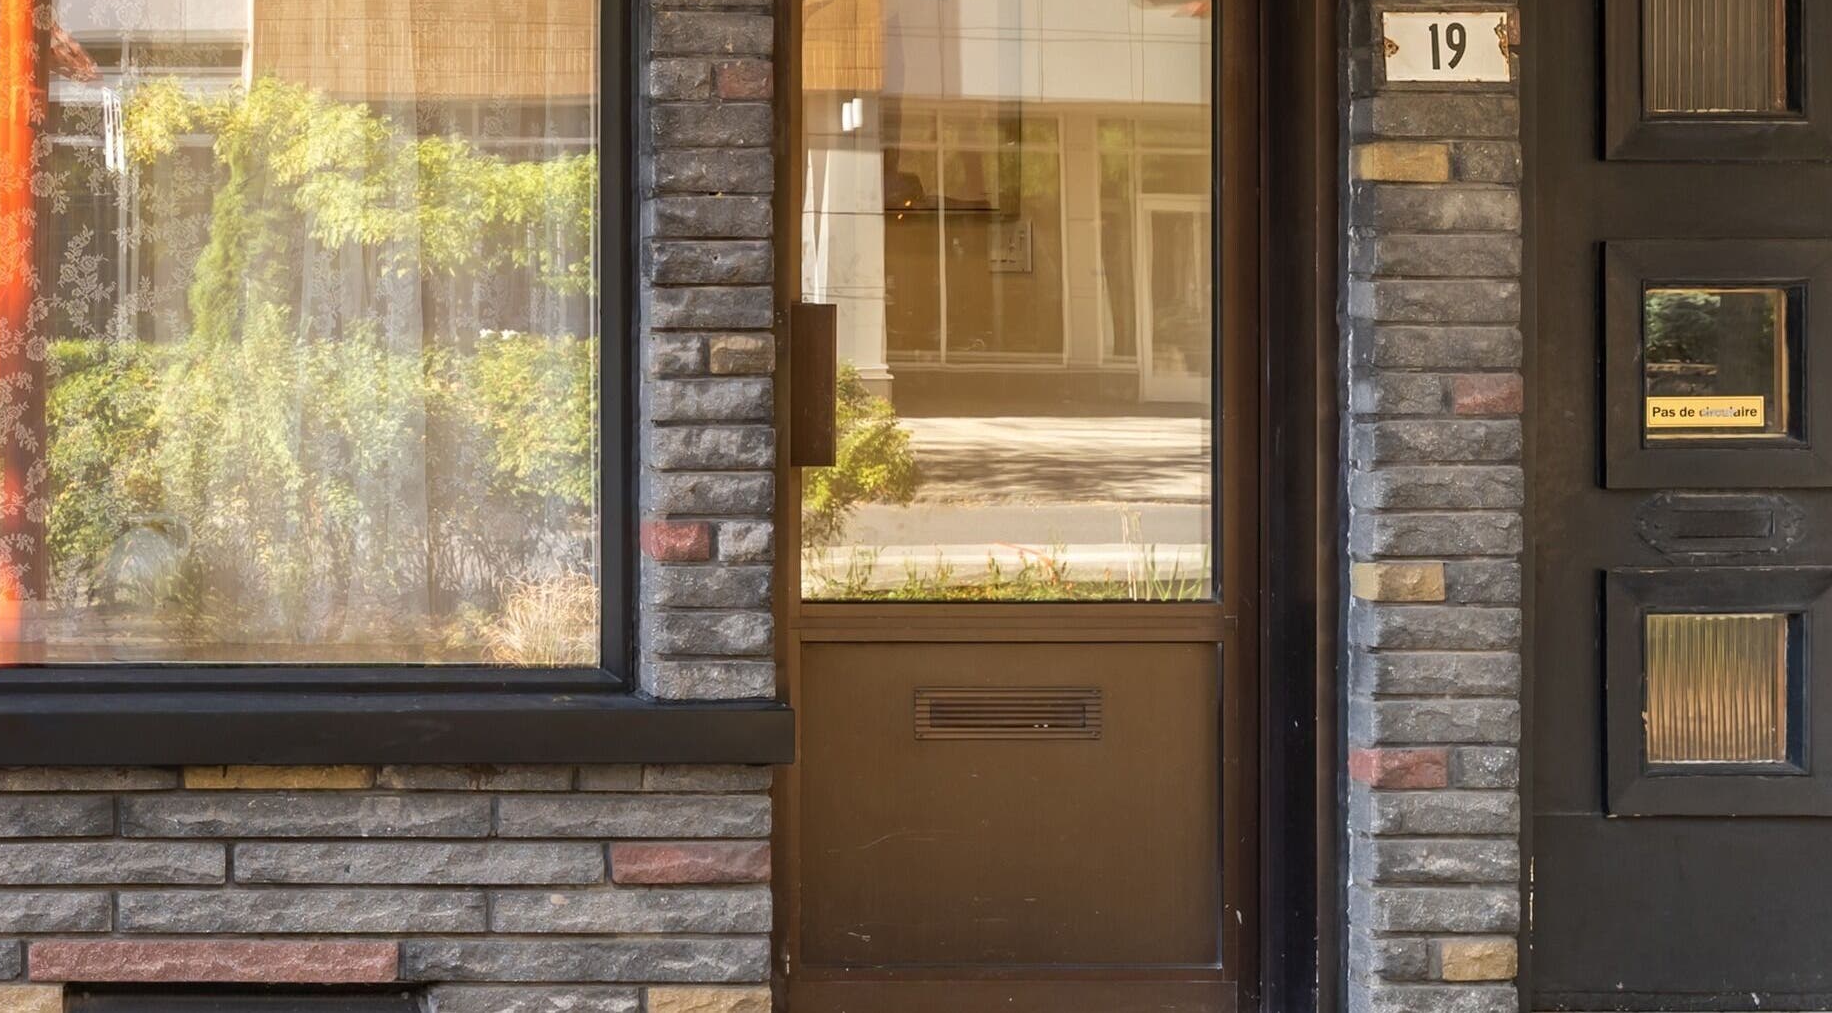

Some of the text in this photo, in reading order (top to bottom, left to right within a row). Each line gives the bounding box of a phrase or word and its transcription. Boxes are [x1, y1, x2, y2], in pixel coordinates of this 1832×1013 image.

[1428, 22, 1467, 70] 19
[1652, 406, 1676, 418] Pas
[1679, 406, 1695, 418] de
